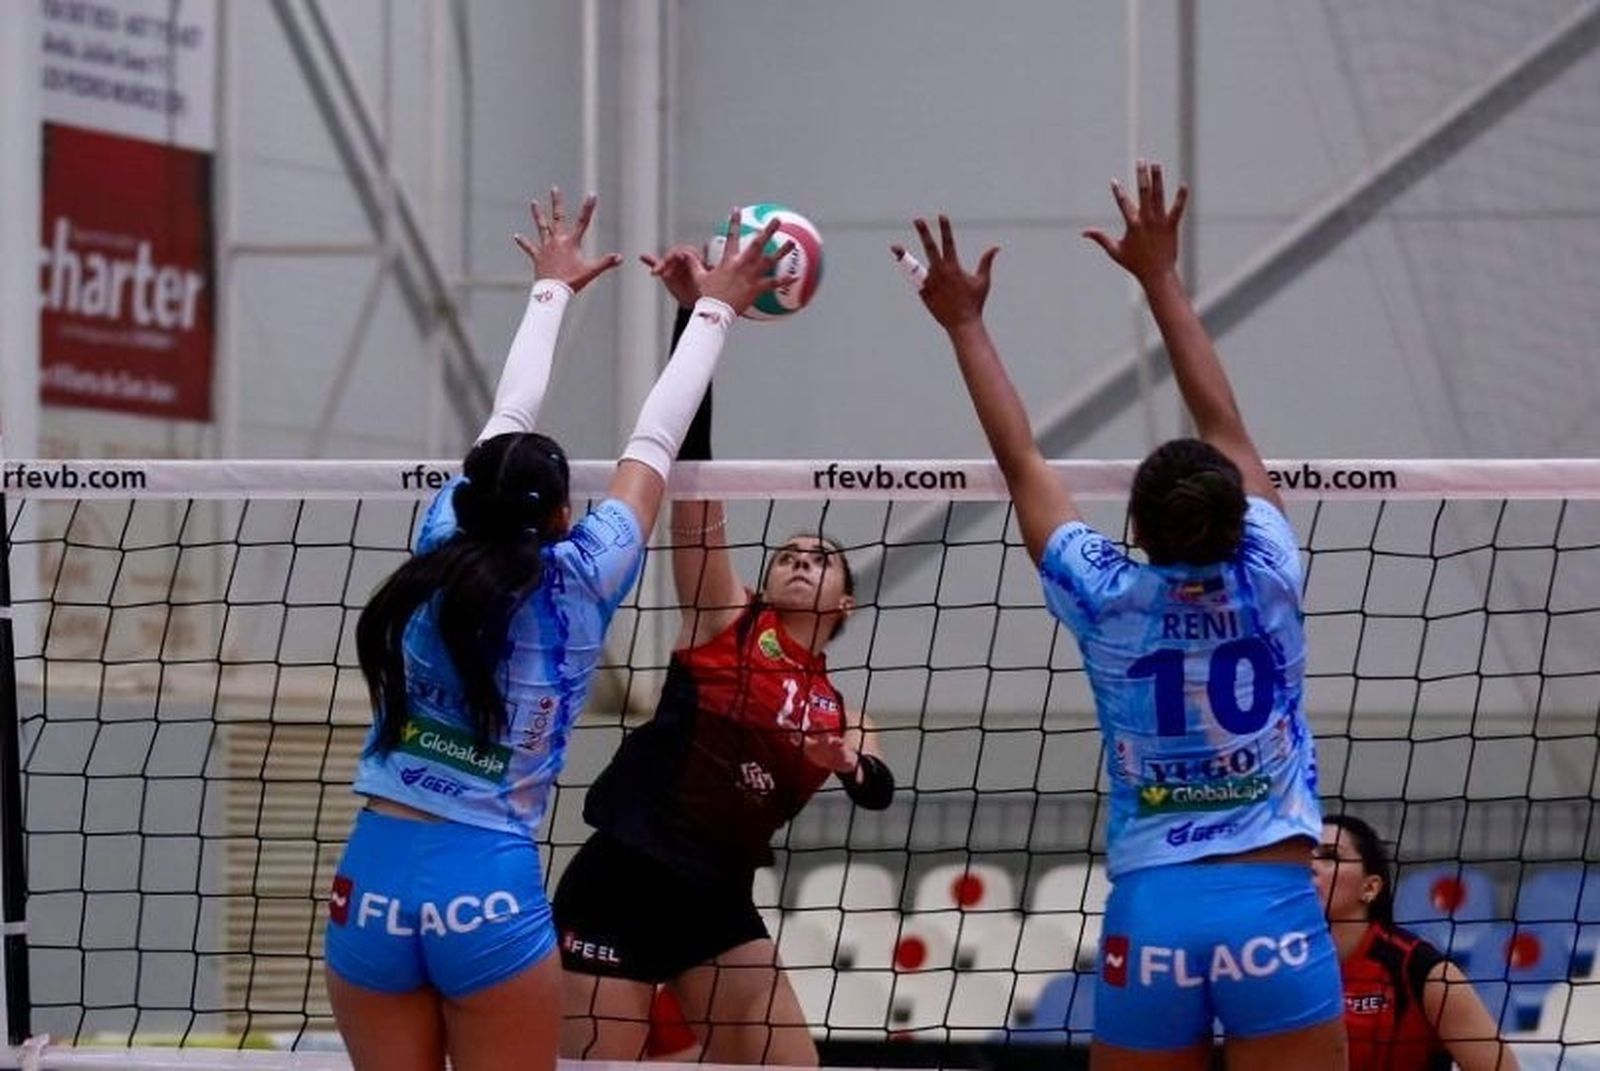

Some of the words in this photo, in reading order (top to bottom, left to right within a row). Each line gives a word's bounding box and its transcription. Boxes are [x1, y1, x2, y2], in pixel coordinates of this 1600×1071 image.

[3, 463, 147, 489] rfevb.com
[814, 463, 966, 489] rfevb.com
[1162, 611, 1239, 640] RENI
[1127, 637, 1275, 738] 10
[418, 731, 505, 775] Globalcaja
[1172, 777, 1269, 803] Globalcaja
[357, 890, 519, 937] FLACO
[571, 940, 620, 963] FEEL
[1140, 931, 1309, 987] FLACO
